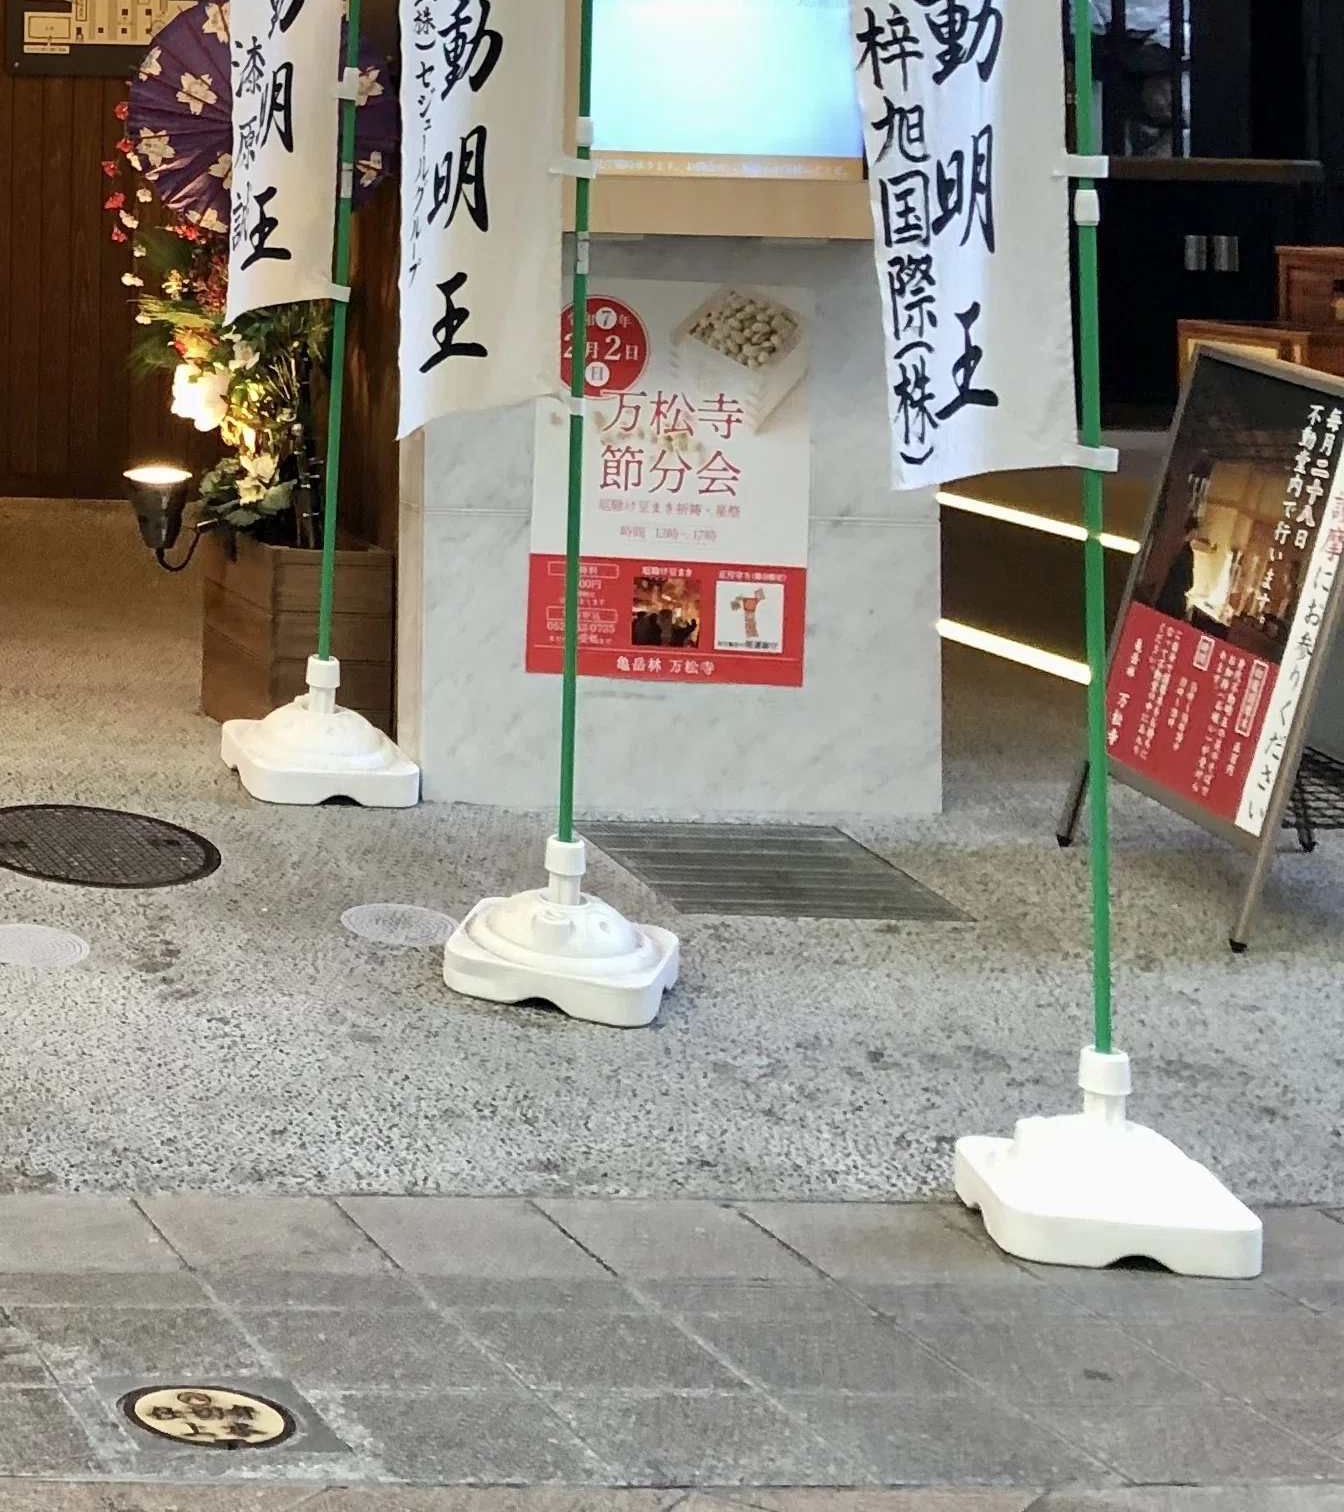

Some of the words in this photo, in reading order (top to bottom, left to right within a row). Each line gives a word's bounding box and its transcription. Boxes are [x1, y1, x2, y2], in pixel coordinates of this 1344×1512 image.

[599, 390, 745, 439] 万松寺
[599, 445, 742, 497] 節分会
